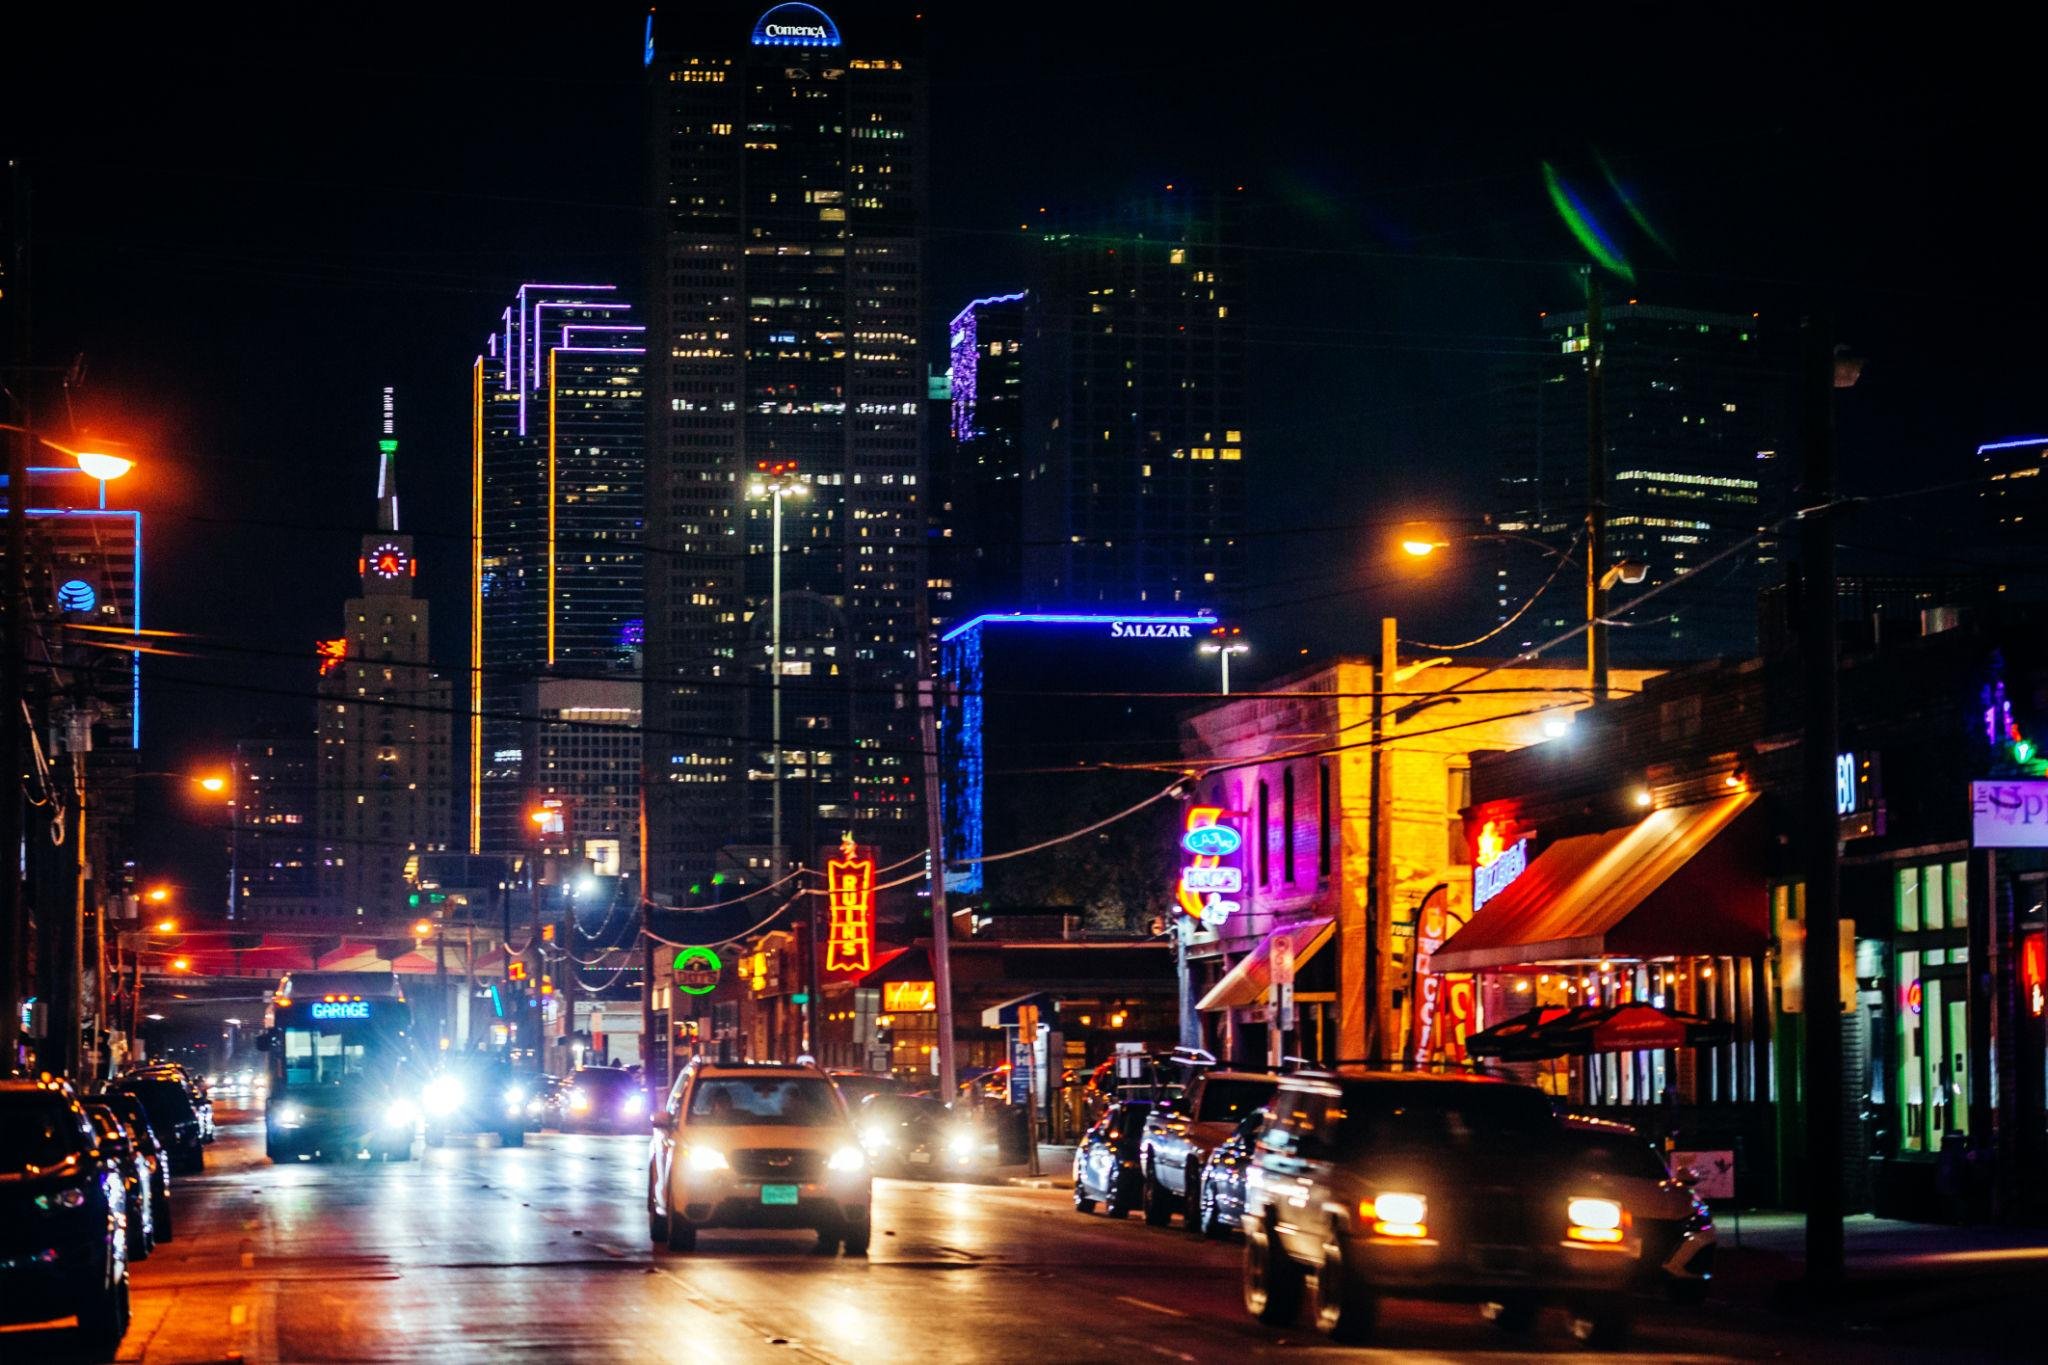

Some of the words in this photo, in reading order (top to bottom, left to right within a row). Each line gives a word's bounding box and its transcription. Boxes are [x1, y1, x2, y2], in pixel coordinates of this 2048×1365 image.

[1111, 621, 1192, 637] SALAZAR
[842, 874, 857, 955] RUINS
[312, 1002, 369, 1018] GARAGE
